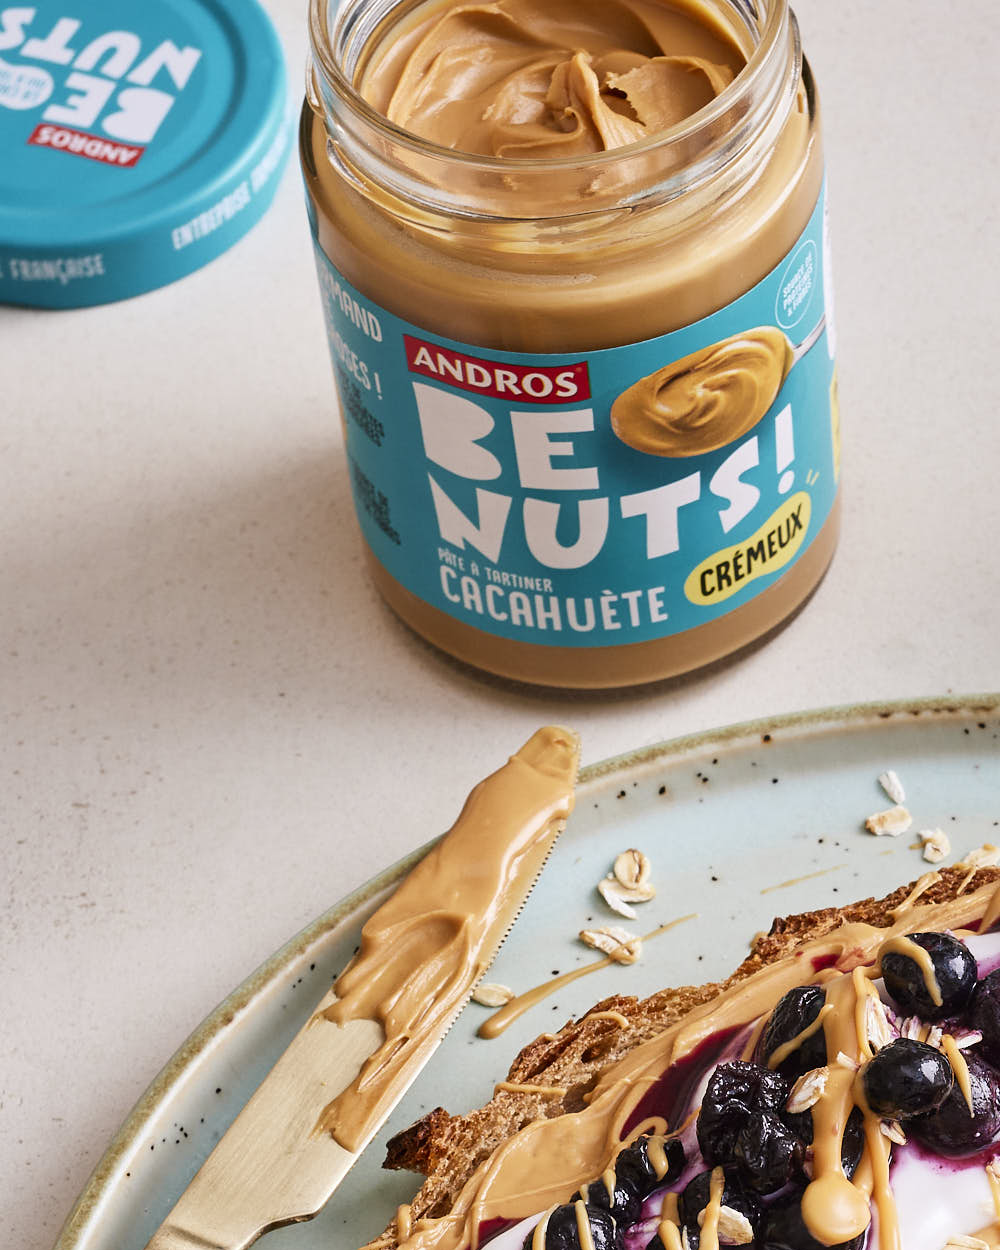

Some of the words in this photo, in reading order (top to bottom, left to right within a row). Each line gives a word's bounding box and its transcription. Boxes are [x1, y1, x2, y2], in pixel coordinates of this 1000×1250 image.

[41, 71, 175, 143] BE
[36, 125, 139, 165] ANDROS
[413, 346, 578, 398] ANDROS
[412, 381, 600, 490] BE
[428, 403, 795, 569] NUTS!
[484, 567, 553, 593] TARTINER
[700, 503, 804, 597] CRÉMEUX
[440, 565, 668, 632] CACAHUÈTE
